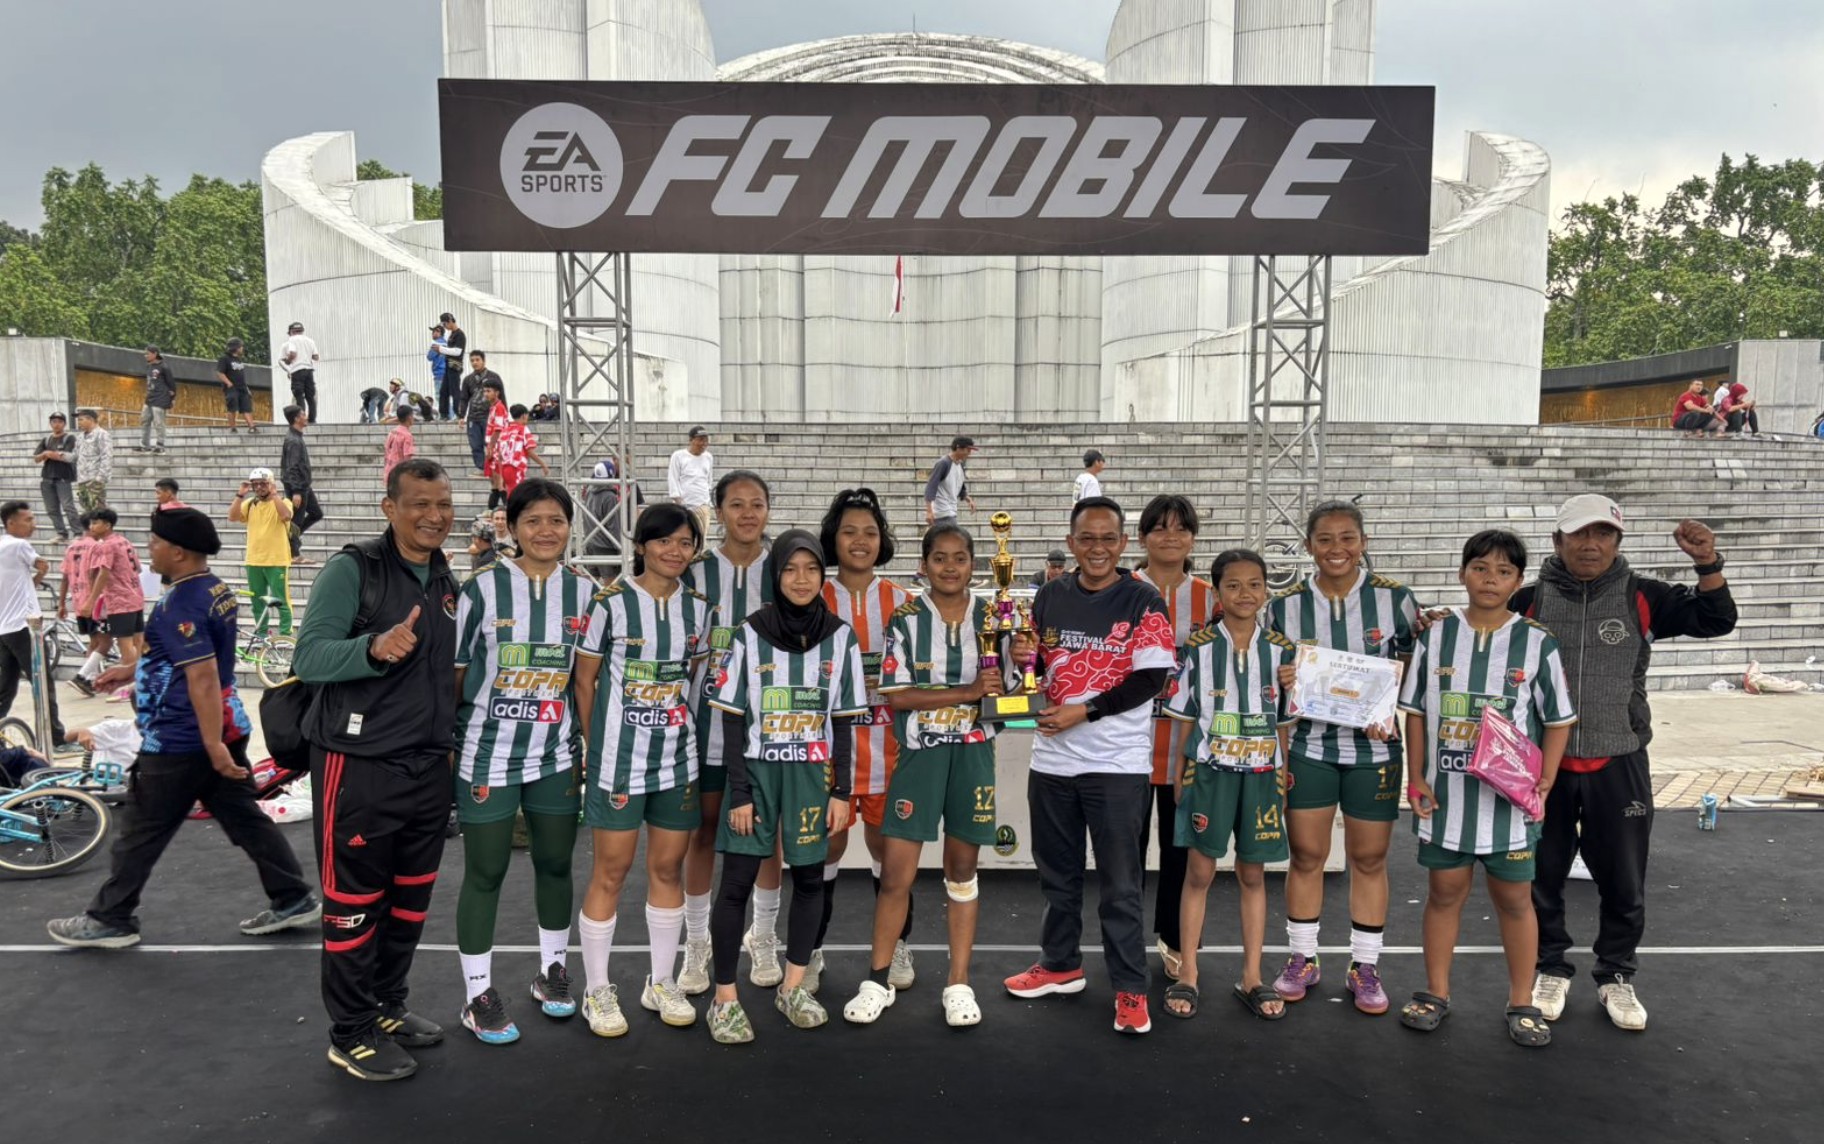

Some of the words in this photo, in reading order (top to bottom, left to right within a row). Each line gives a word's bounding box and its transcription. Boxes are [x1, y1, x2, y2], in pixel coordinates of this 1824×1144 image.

[522, 131, 602, 171] EA
[624, 115, 832, 217] FC
[820, 116, 1376, 219] MOBILE
[521, 174, 603, 193] SPORTS
[1060, 634, 1105, 645] FESTIVAL
[1060, 640, 1088, 650] JAWA
[1091, 643, 1127, 654] BARAT
[494, 671, 569, 692] COPA
[1210, 738, 1277, 759] COPA
[800, 806, 821, 833] 17
[1255, 804, 1279, 829] 14
[1255, 831, 1281, 841] COPA
